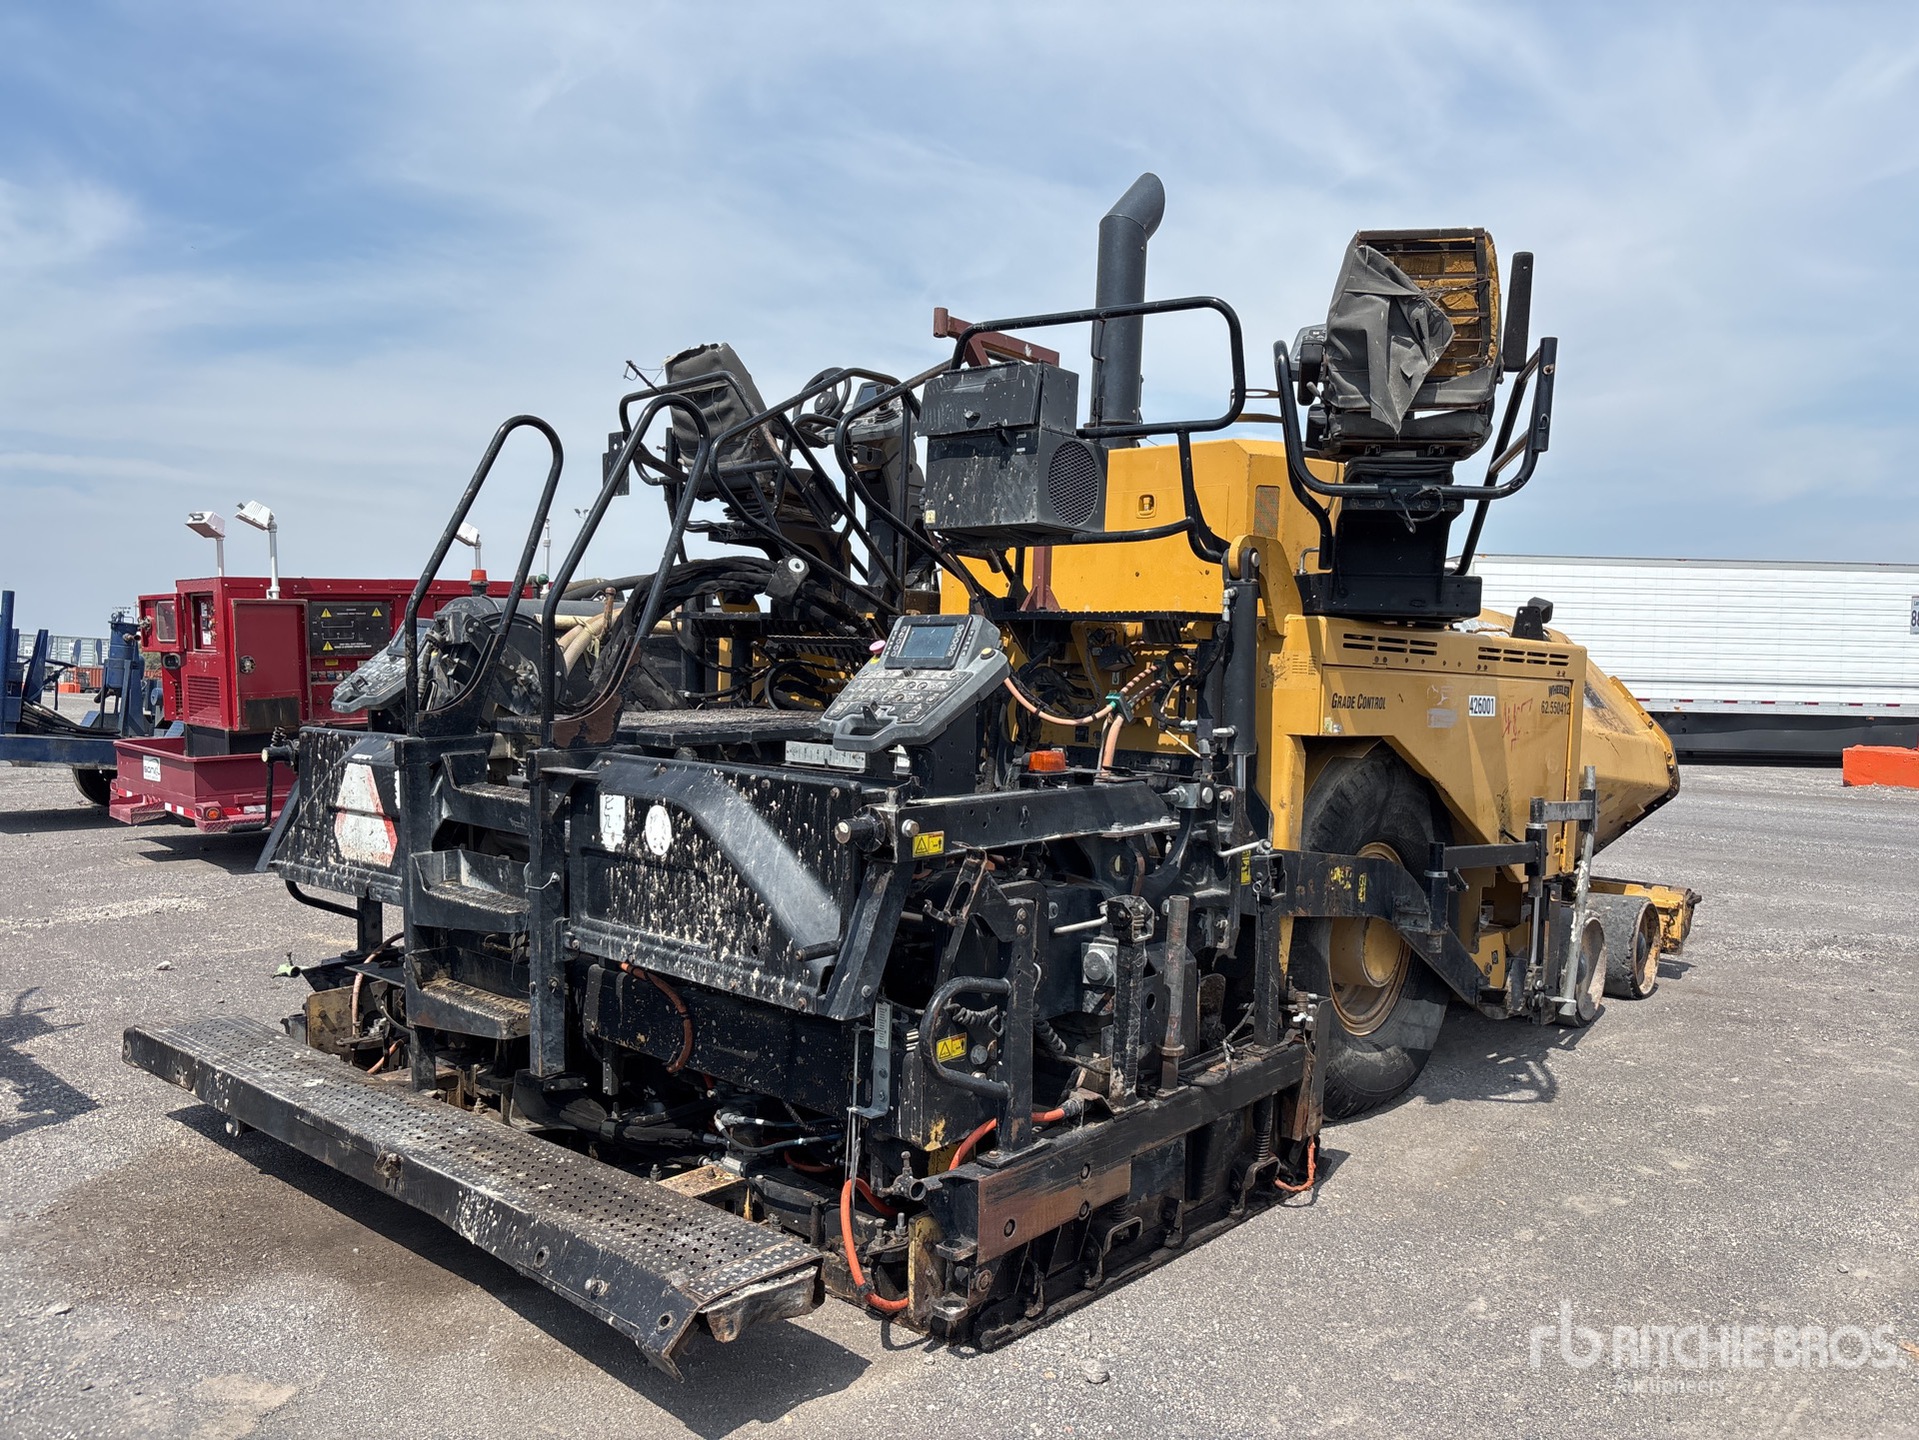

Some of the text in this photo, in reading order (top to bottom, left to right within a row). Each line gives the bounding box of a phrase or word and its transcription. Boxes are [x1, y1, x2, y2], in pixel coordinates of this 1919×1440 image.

[1331, 692, 1386, 710] GRADE CONTROL
[1548, 685, 1570, 699] WHEELER
[1469, 697, 1495, 715] 426001
